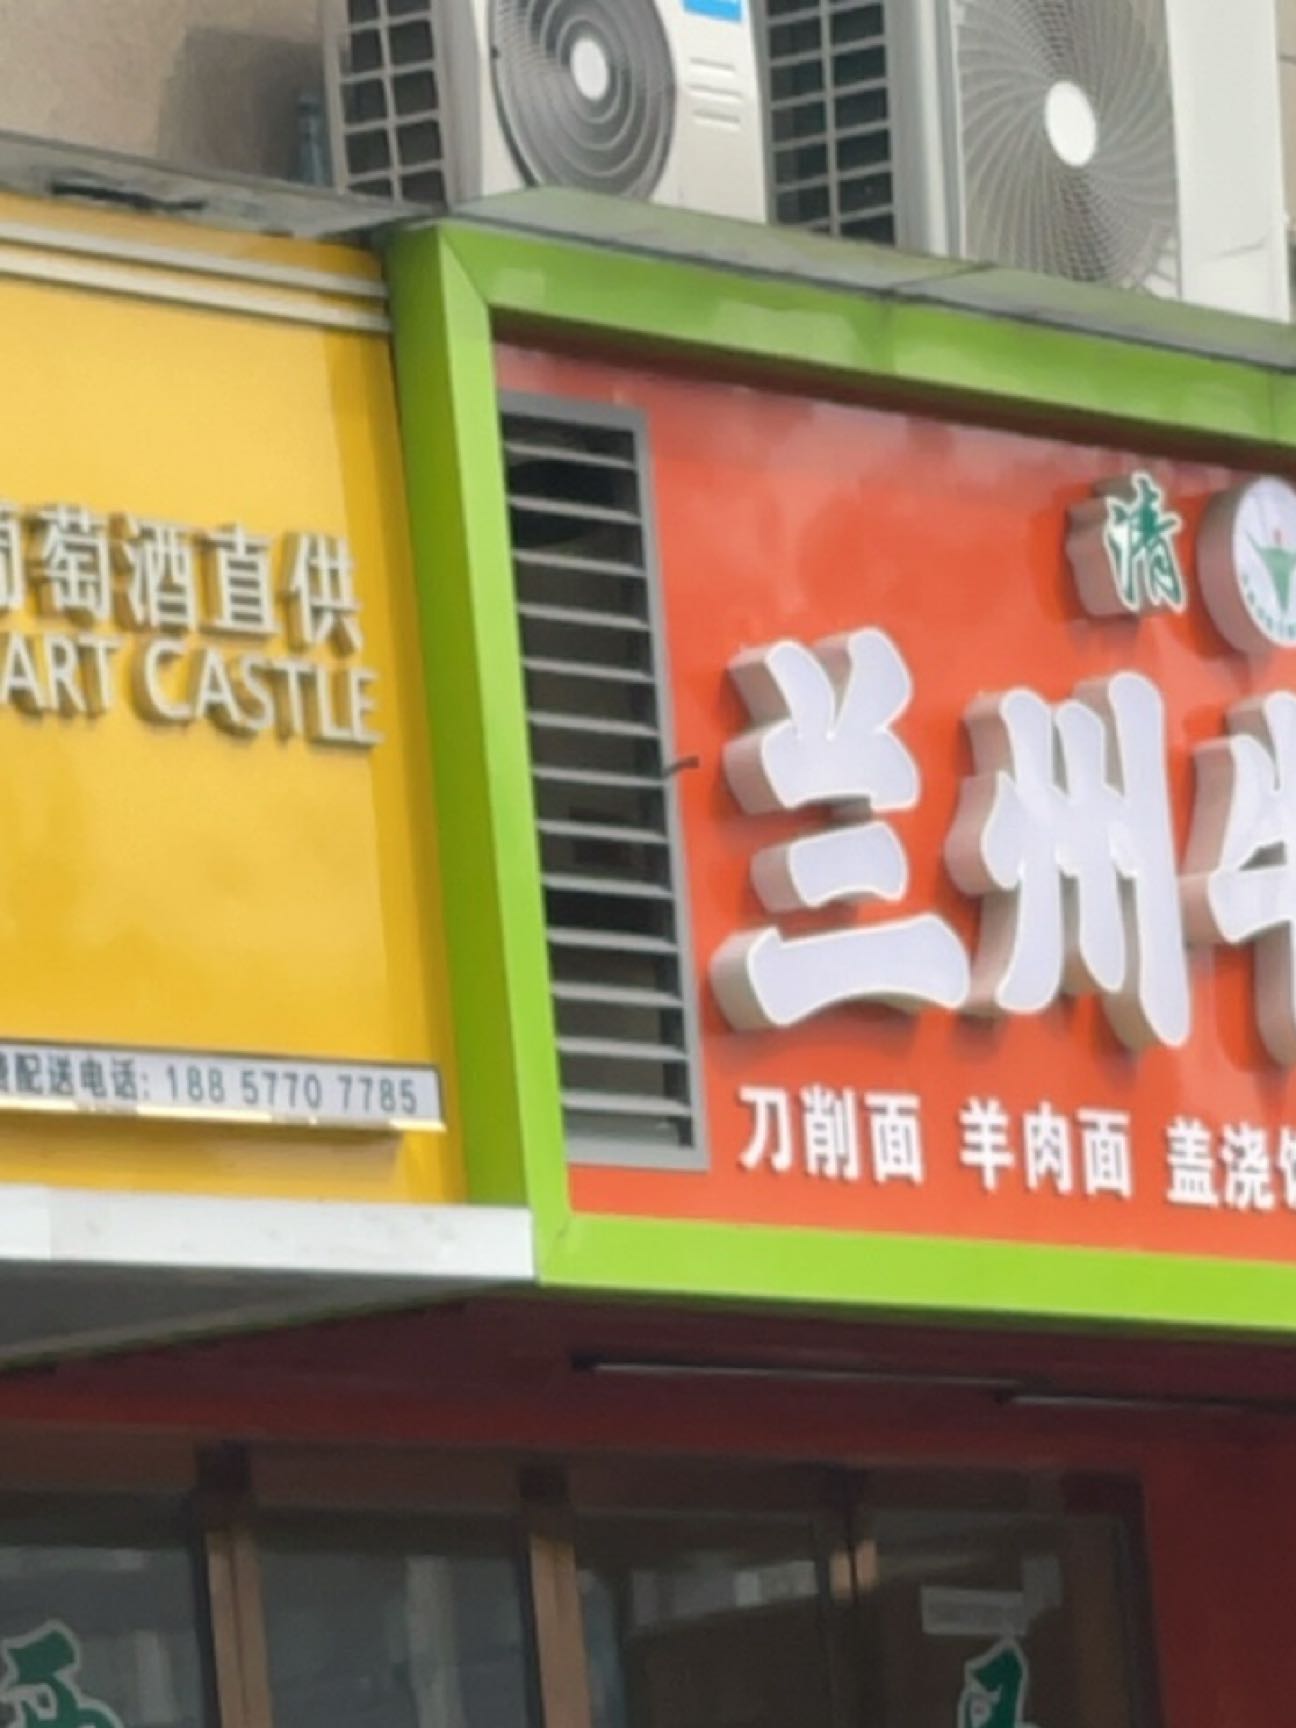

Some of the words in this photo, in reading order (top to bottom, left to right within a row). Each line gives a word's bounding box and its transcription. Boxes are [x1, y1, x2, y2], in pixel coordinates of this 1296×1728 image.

[0, 500, 366, 656] 萄酒直供
[1104, 470, 1189, 612] 清
[143, 638, 384, 746] CASTLE
[167, 1065, 226, 1105] 188
[241, 1070, 323, 1110] 5770
[338, 1075, 419, 1116] 7785
[738, 1084, 925, 1184] 刀削面
[958, 1096, 1133, 1199] 羊肉面
